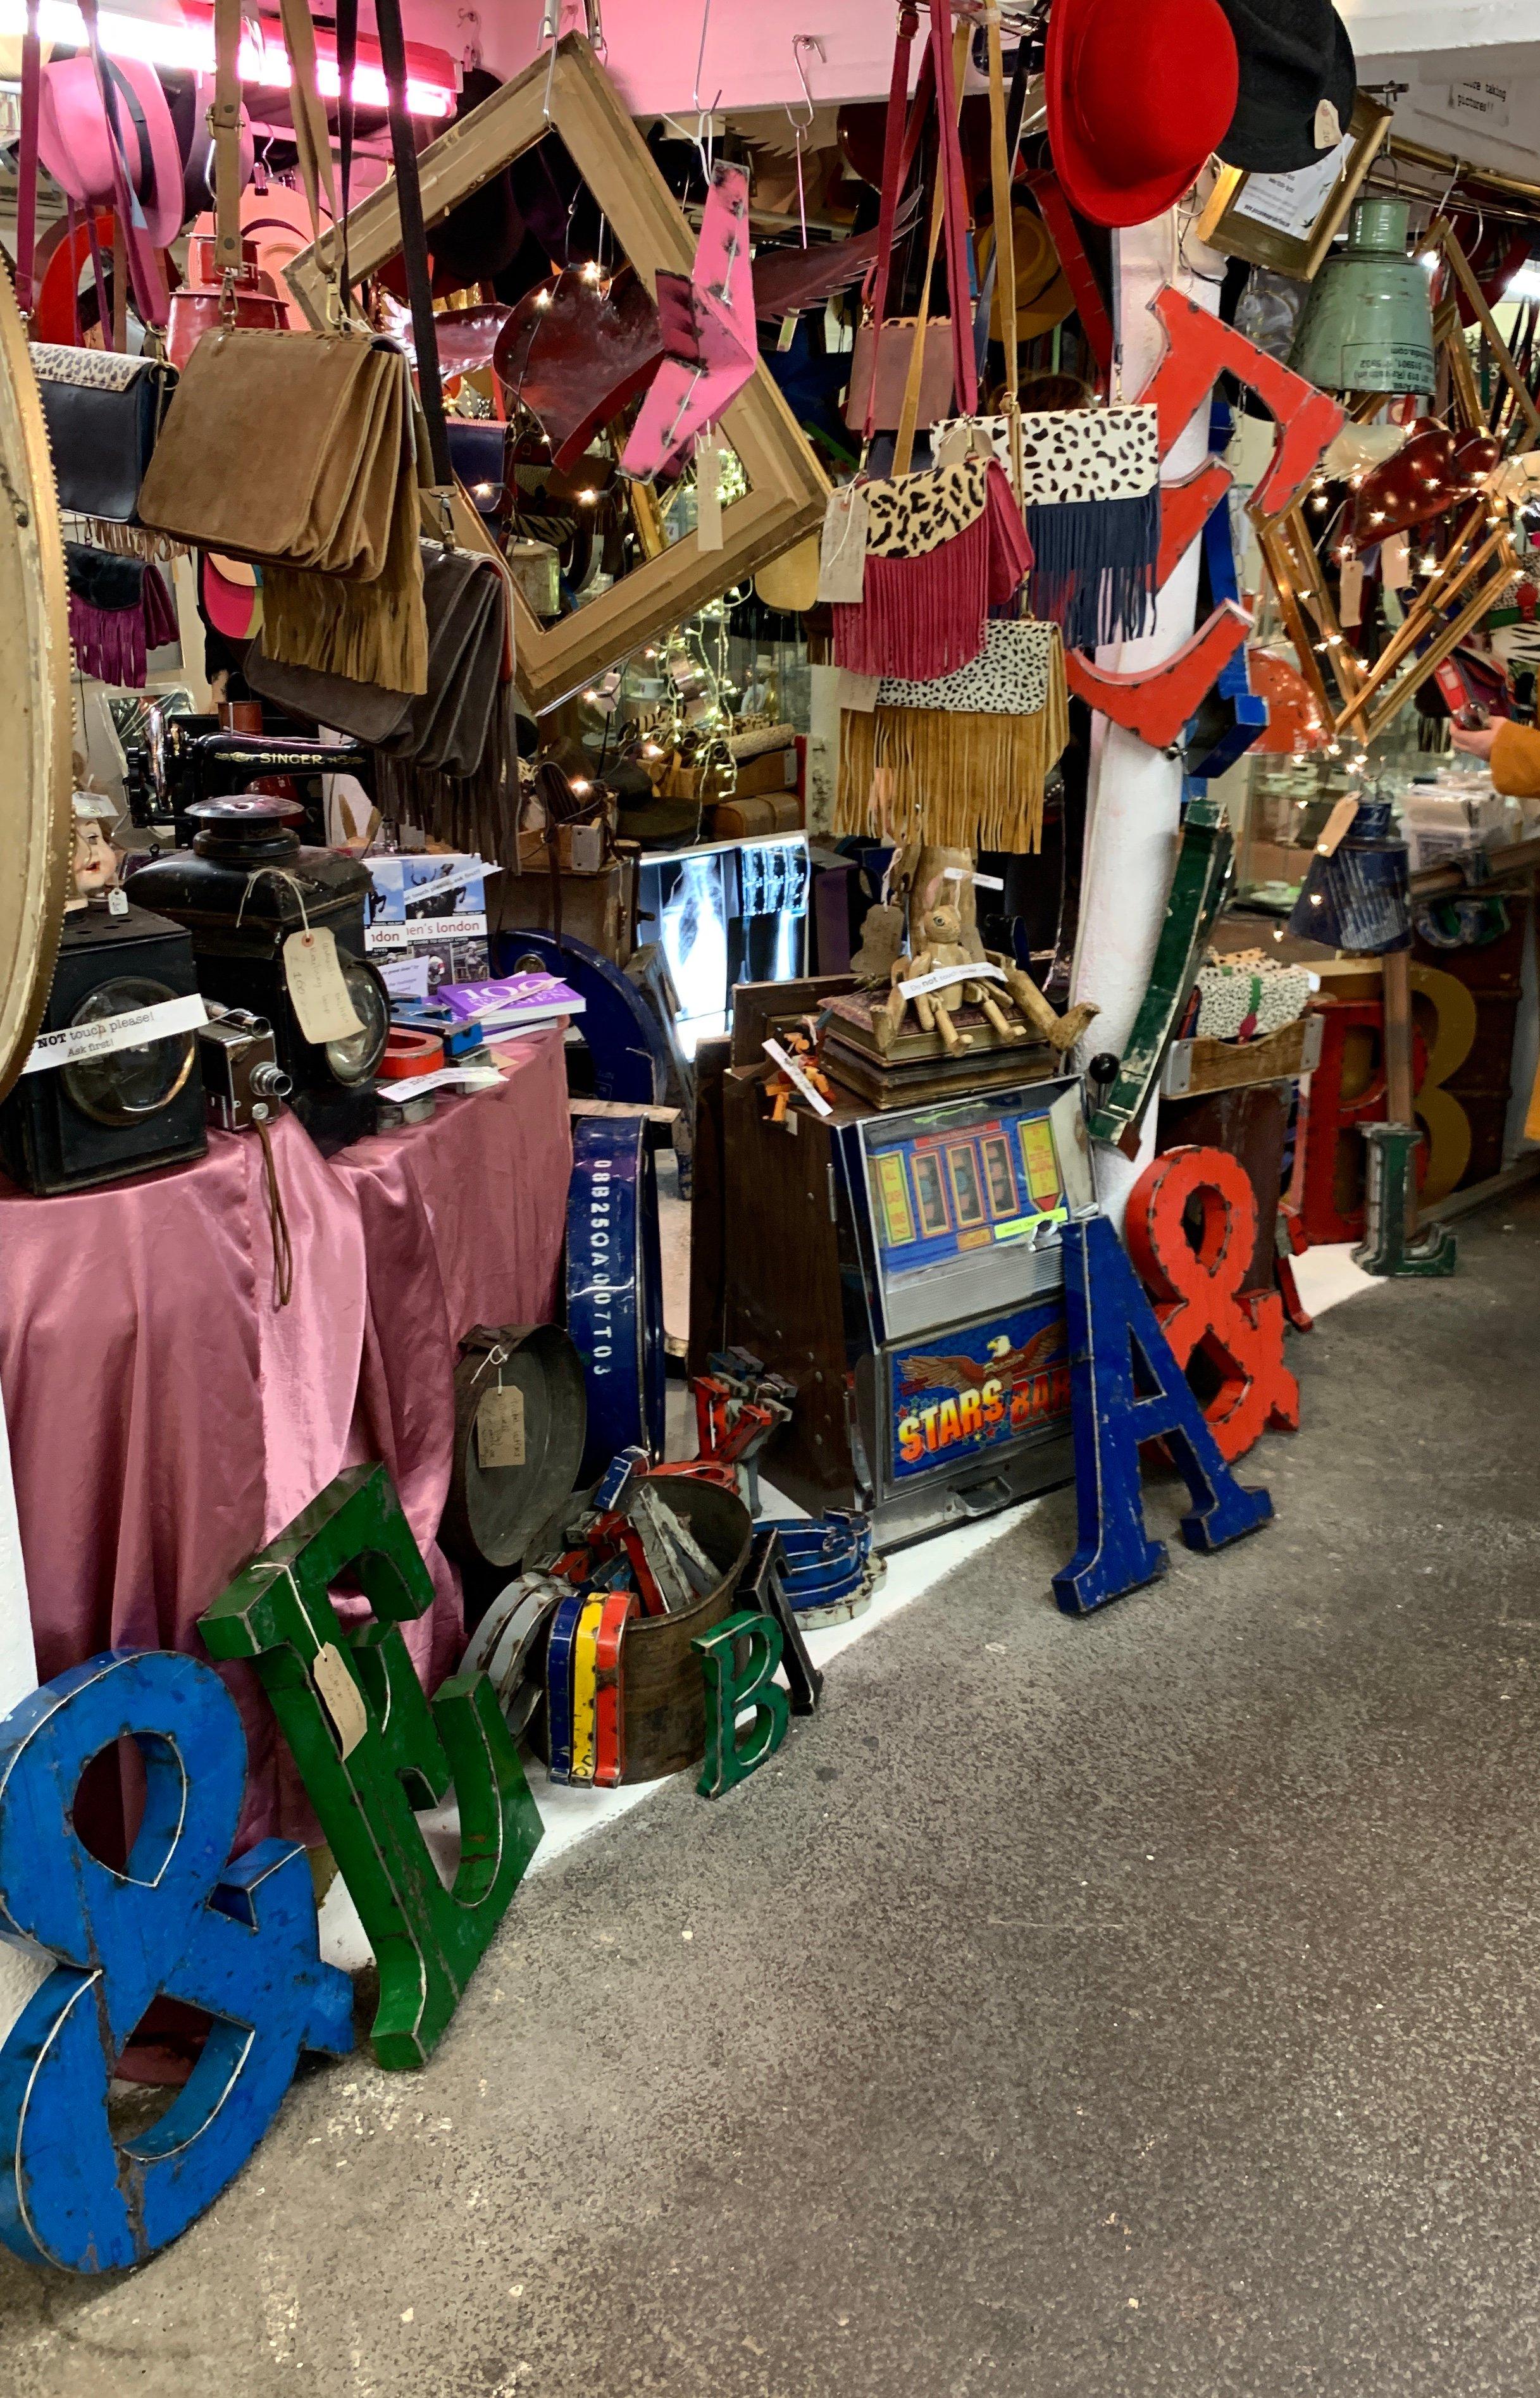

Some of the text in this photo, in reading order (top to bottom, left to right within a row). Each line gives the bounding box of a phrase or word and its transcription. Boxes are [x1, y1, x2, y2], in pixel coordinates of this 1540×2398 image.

[260, 752, 325, 765] SINGER
[436, 921, 480, 933] london
[921, 976, 939, 987] not
[36, 1012, 155, 1048] NOT touch please!
[67, 1038, 115, 1057] Ask first!
[1123, 1144, 1300, 1467] &
[898, 1378, 1007, 1463] STARS
[1051, 1215, 1274, 1616] A
[691, 1610, 790, 1801] B
[198, 1462, 545, 2070] E
[0, 1649, 354, 2275] &
